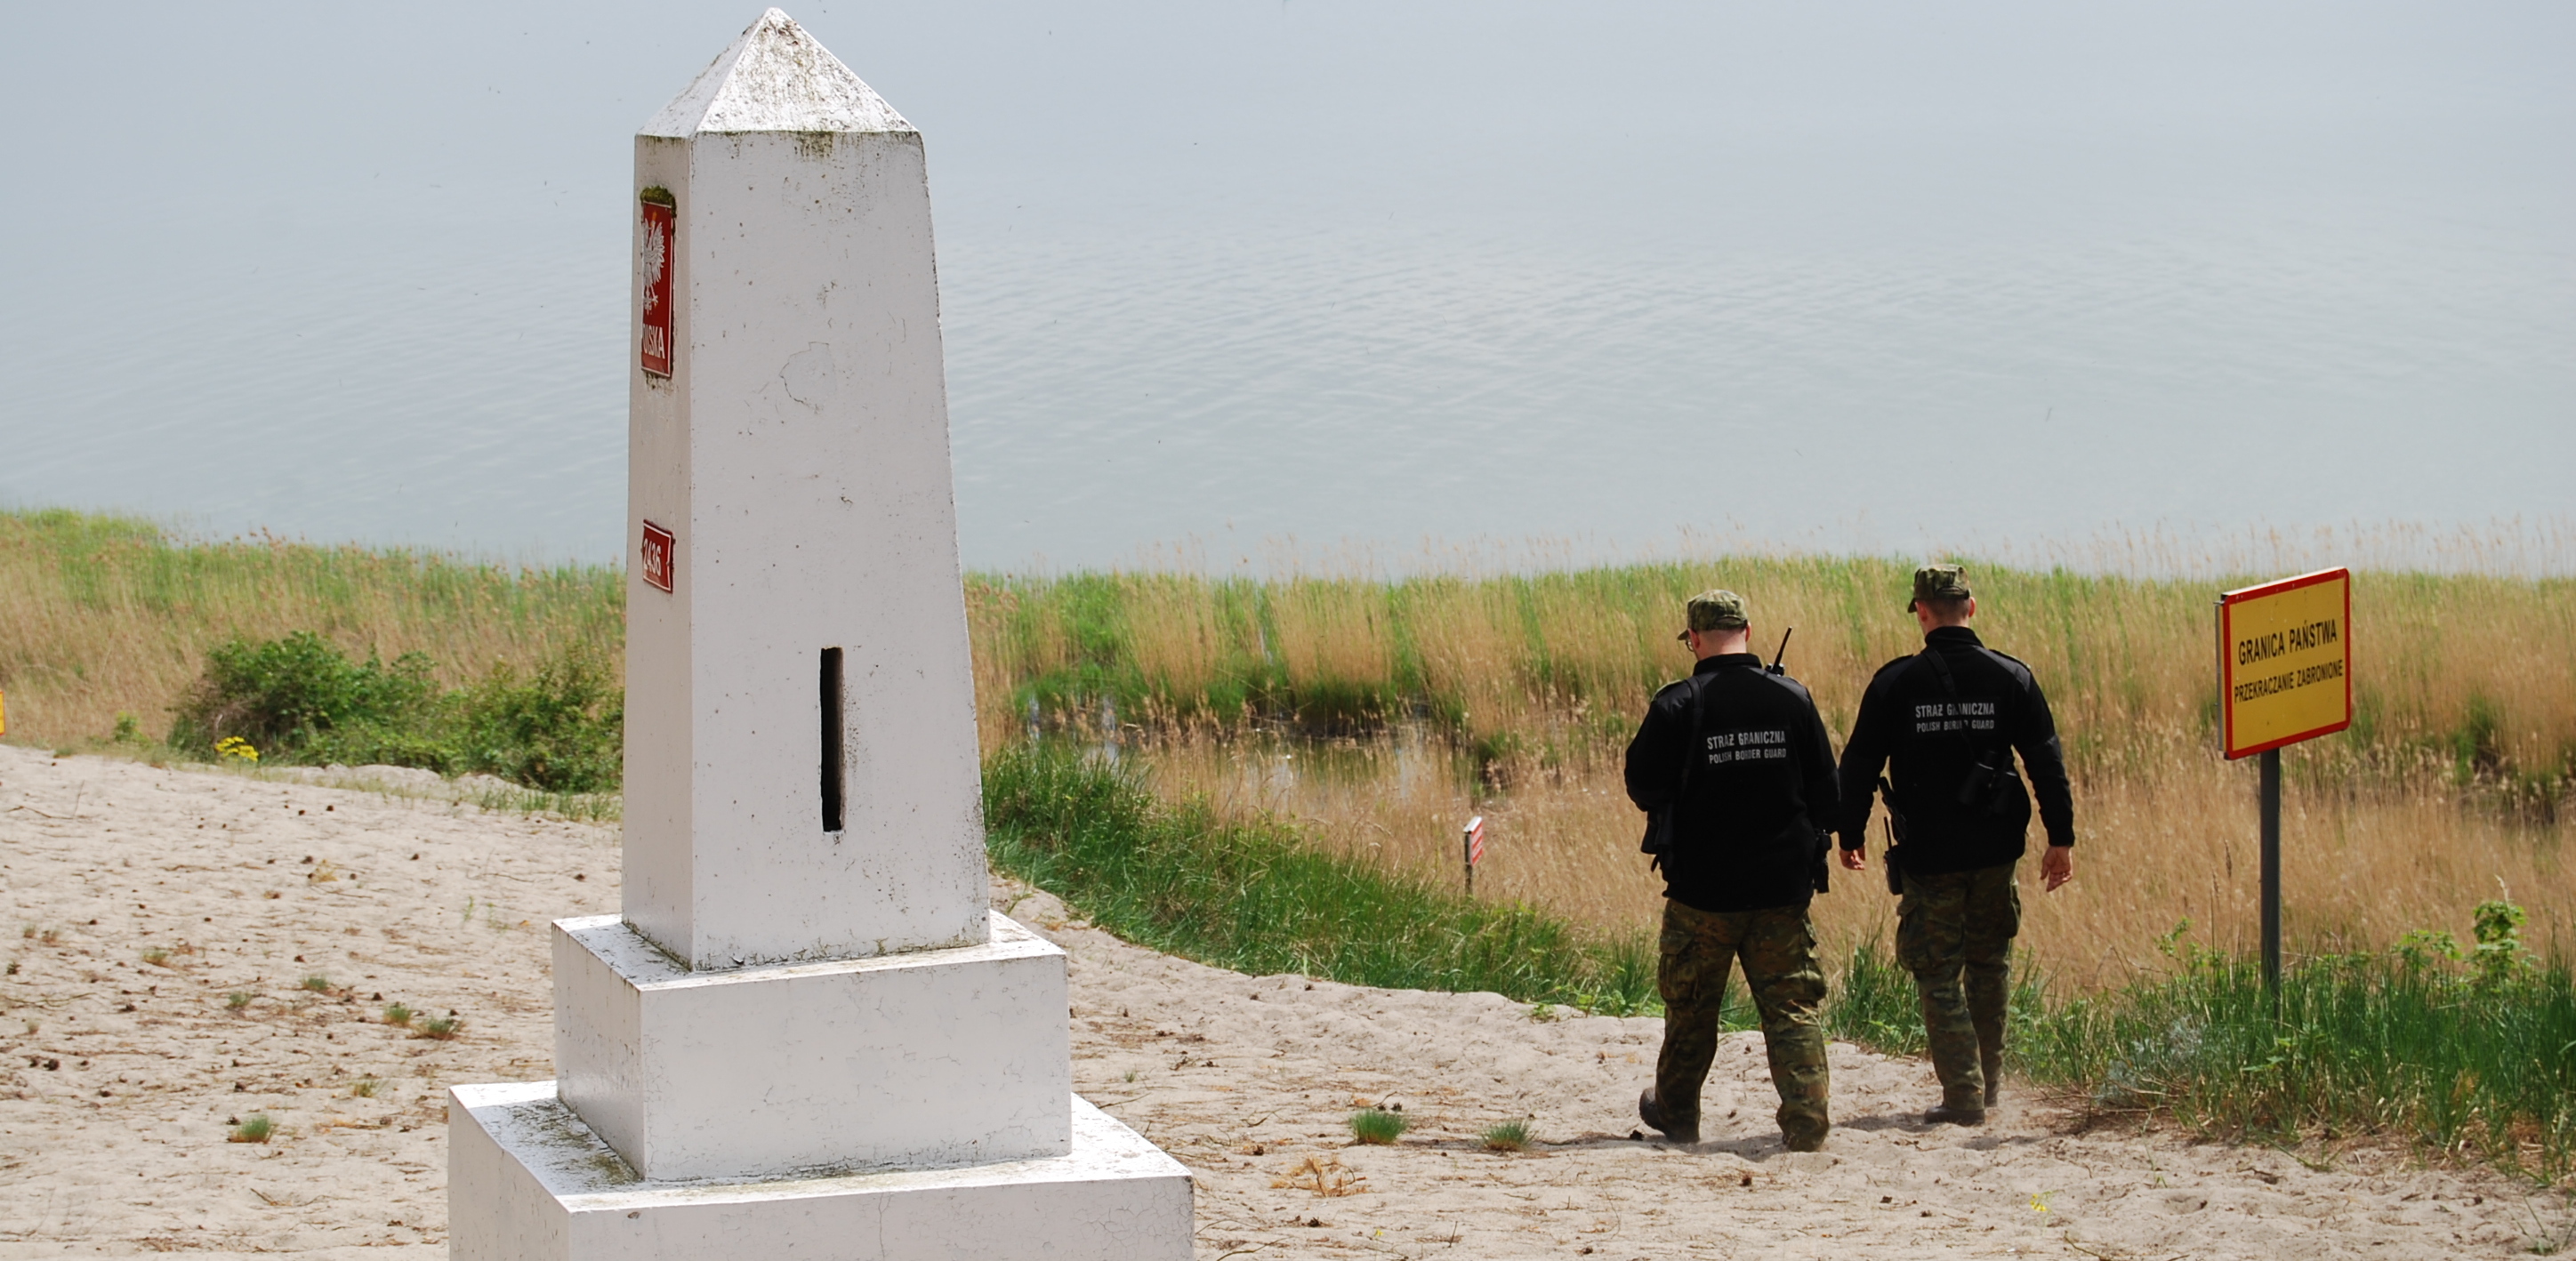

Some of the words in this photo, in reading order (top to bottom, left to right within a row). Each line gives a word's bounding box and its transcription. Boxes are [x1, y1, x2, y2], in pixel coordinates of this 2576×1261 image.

[642, 323, 665, 359] OLSKA
[643, 537, 662, 577] 2436
[2238, 630, 2285, 666] GRANICA
[2289, 619, 2338, 654] PAŃSTWA
[2234, 671, 2294, 704] PRZEKRACZANIE
[2297, 660, 2343, 687] ZABRONIONE
[1738, 731, 1785, 745] GRANICZNA
[1916, 721, 1941, 733] POLISH
[1971, 719, 1995, 730] GUARD
[1709, 751, 1732, 764] POLISH
[1735, 749, 1760, 760] BORDER
[1764, 748, 1787, 759] GUARD
